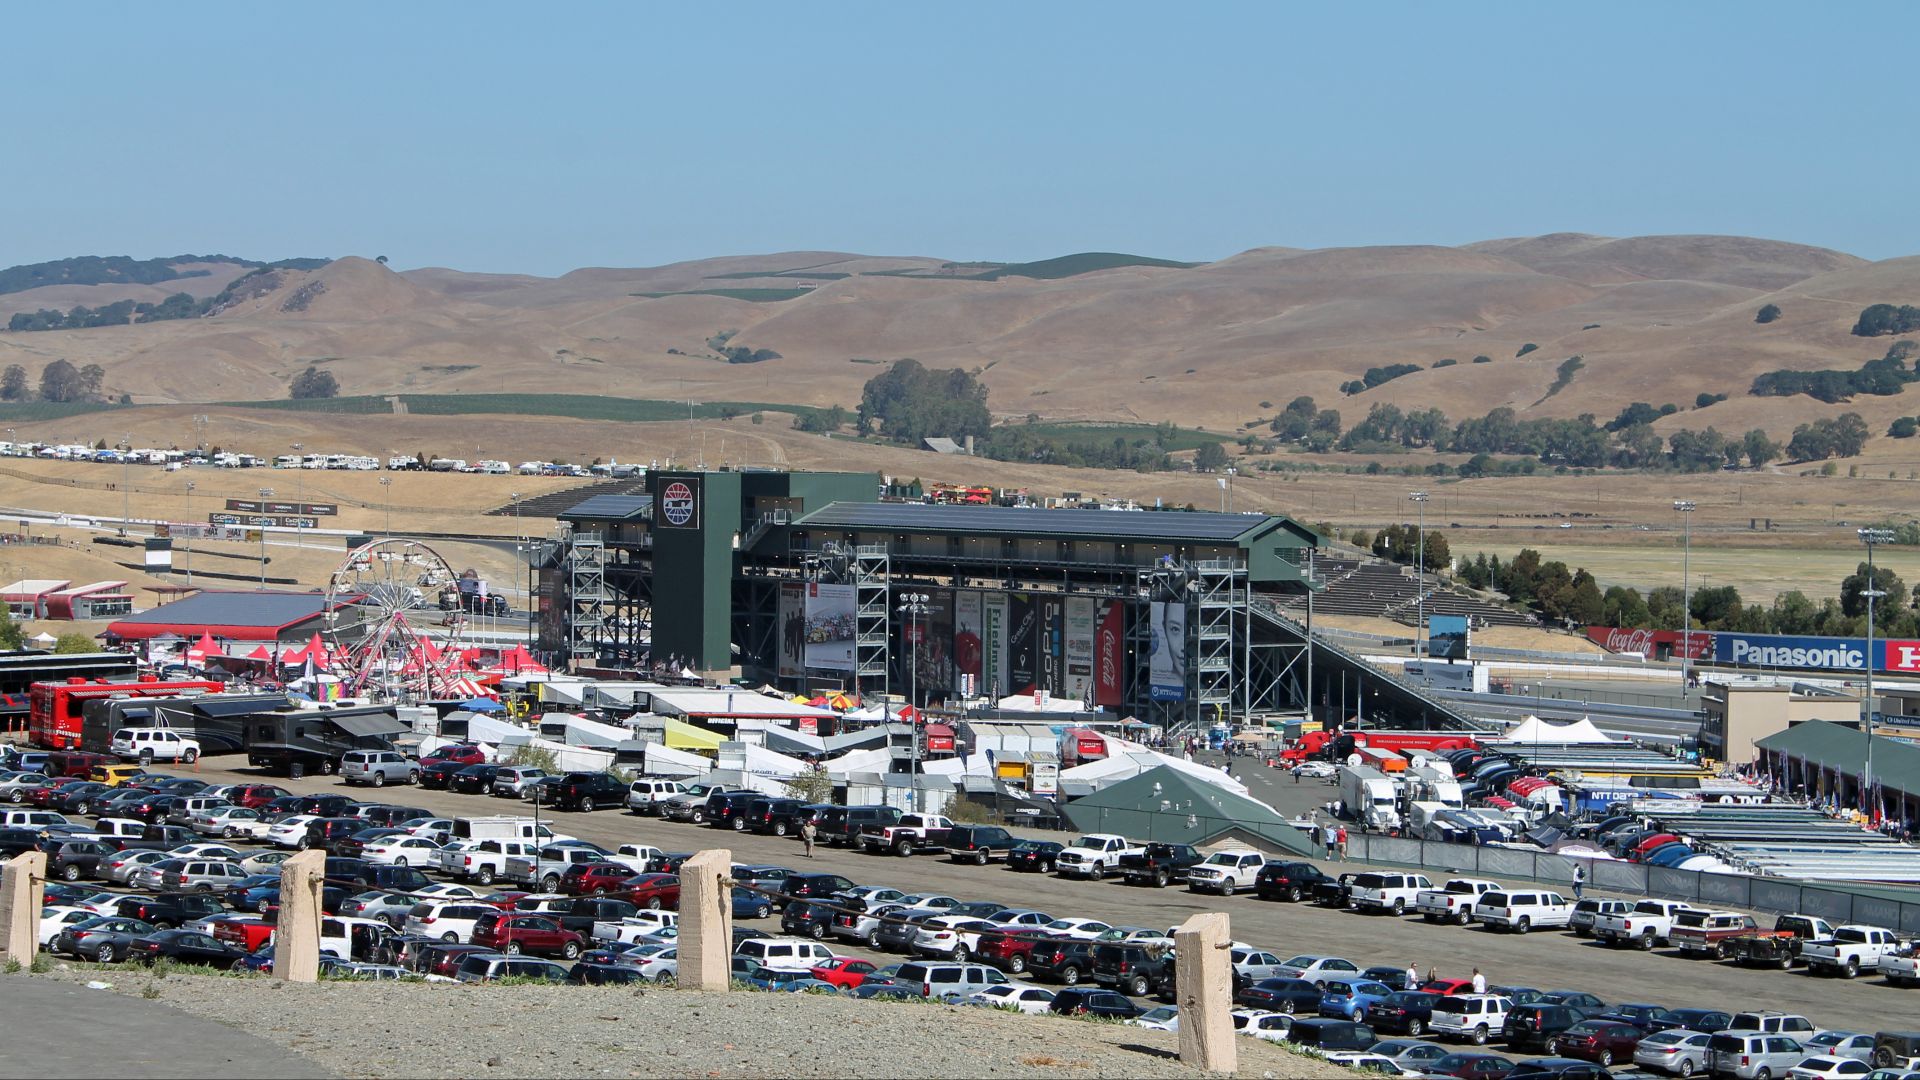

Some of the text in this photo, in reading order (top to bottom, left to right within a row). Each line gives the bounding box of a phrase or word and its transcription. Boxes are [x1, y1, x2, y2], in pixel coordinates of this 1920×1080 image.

[1606, 628, 1654, 655] Coca-Cola
[1732, 639, 1863, 668] Panasonic
[1592, 792, 1612, 800] NTT
[928, 818, 936, 827] 12
